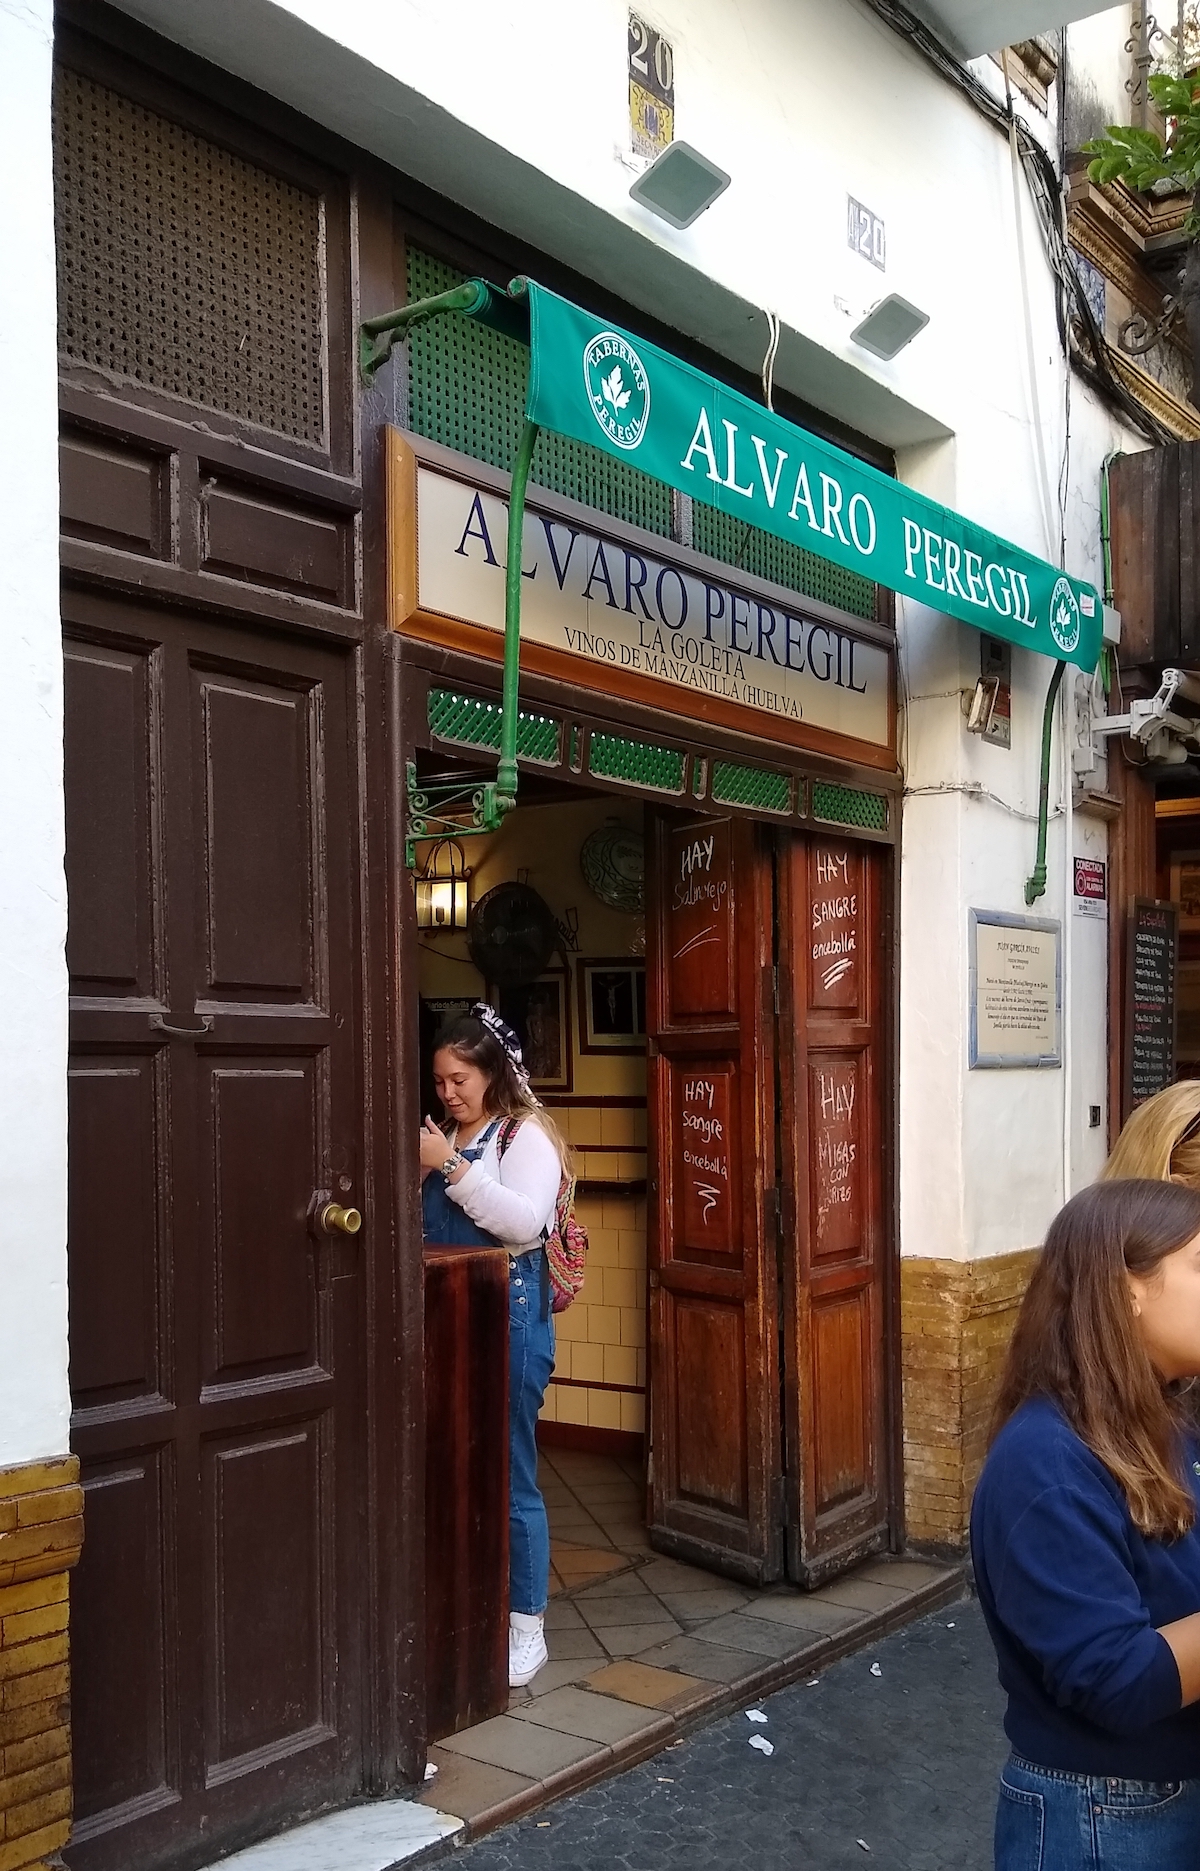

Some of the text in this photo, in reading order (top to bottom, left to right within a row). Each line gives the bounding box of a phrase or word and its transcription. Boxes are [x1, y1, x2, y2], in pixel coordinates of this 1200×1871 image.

[630, 19, 672, 91] 20
[588, 340, 646, 391] TABERNAS
[593, 393, 641, 441] PEREGIL
[680, 406, 1038, 629] ALVARO PEREGIL
[638, 620, 746, 681] LA GOLETA
[701, 581, 868, 694] PEREGIL
[564, 626, 803, 720] VINOS DE MANZANILLA (HUELVA)
[681, 835, 714, 881] HAY
[816, 850, 849, 885] HAY
[812, 894, 858, 930] SANGRE
[685, 1080, 714, 1110] HAY
[821, 1074, 855, 1121] HAY
[830, 1163, 850, 1184] CON
